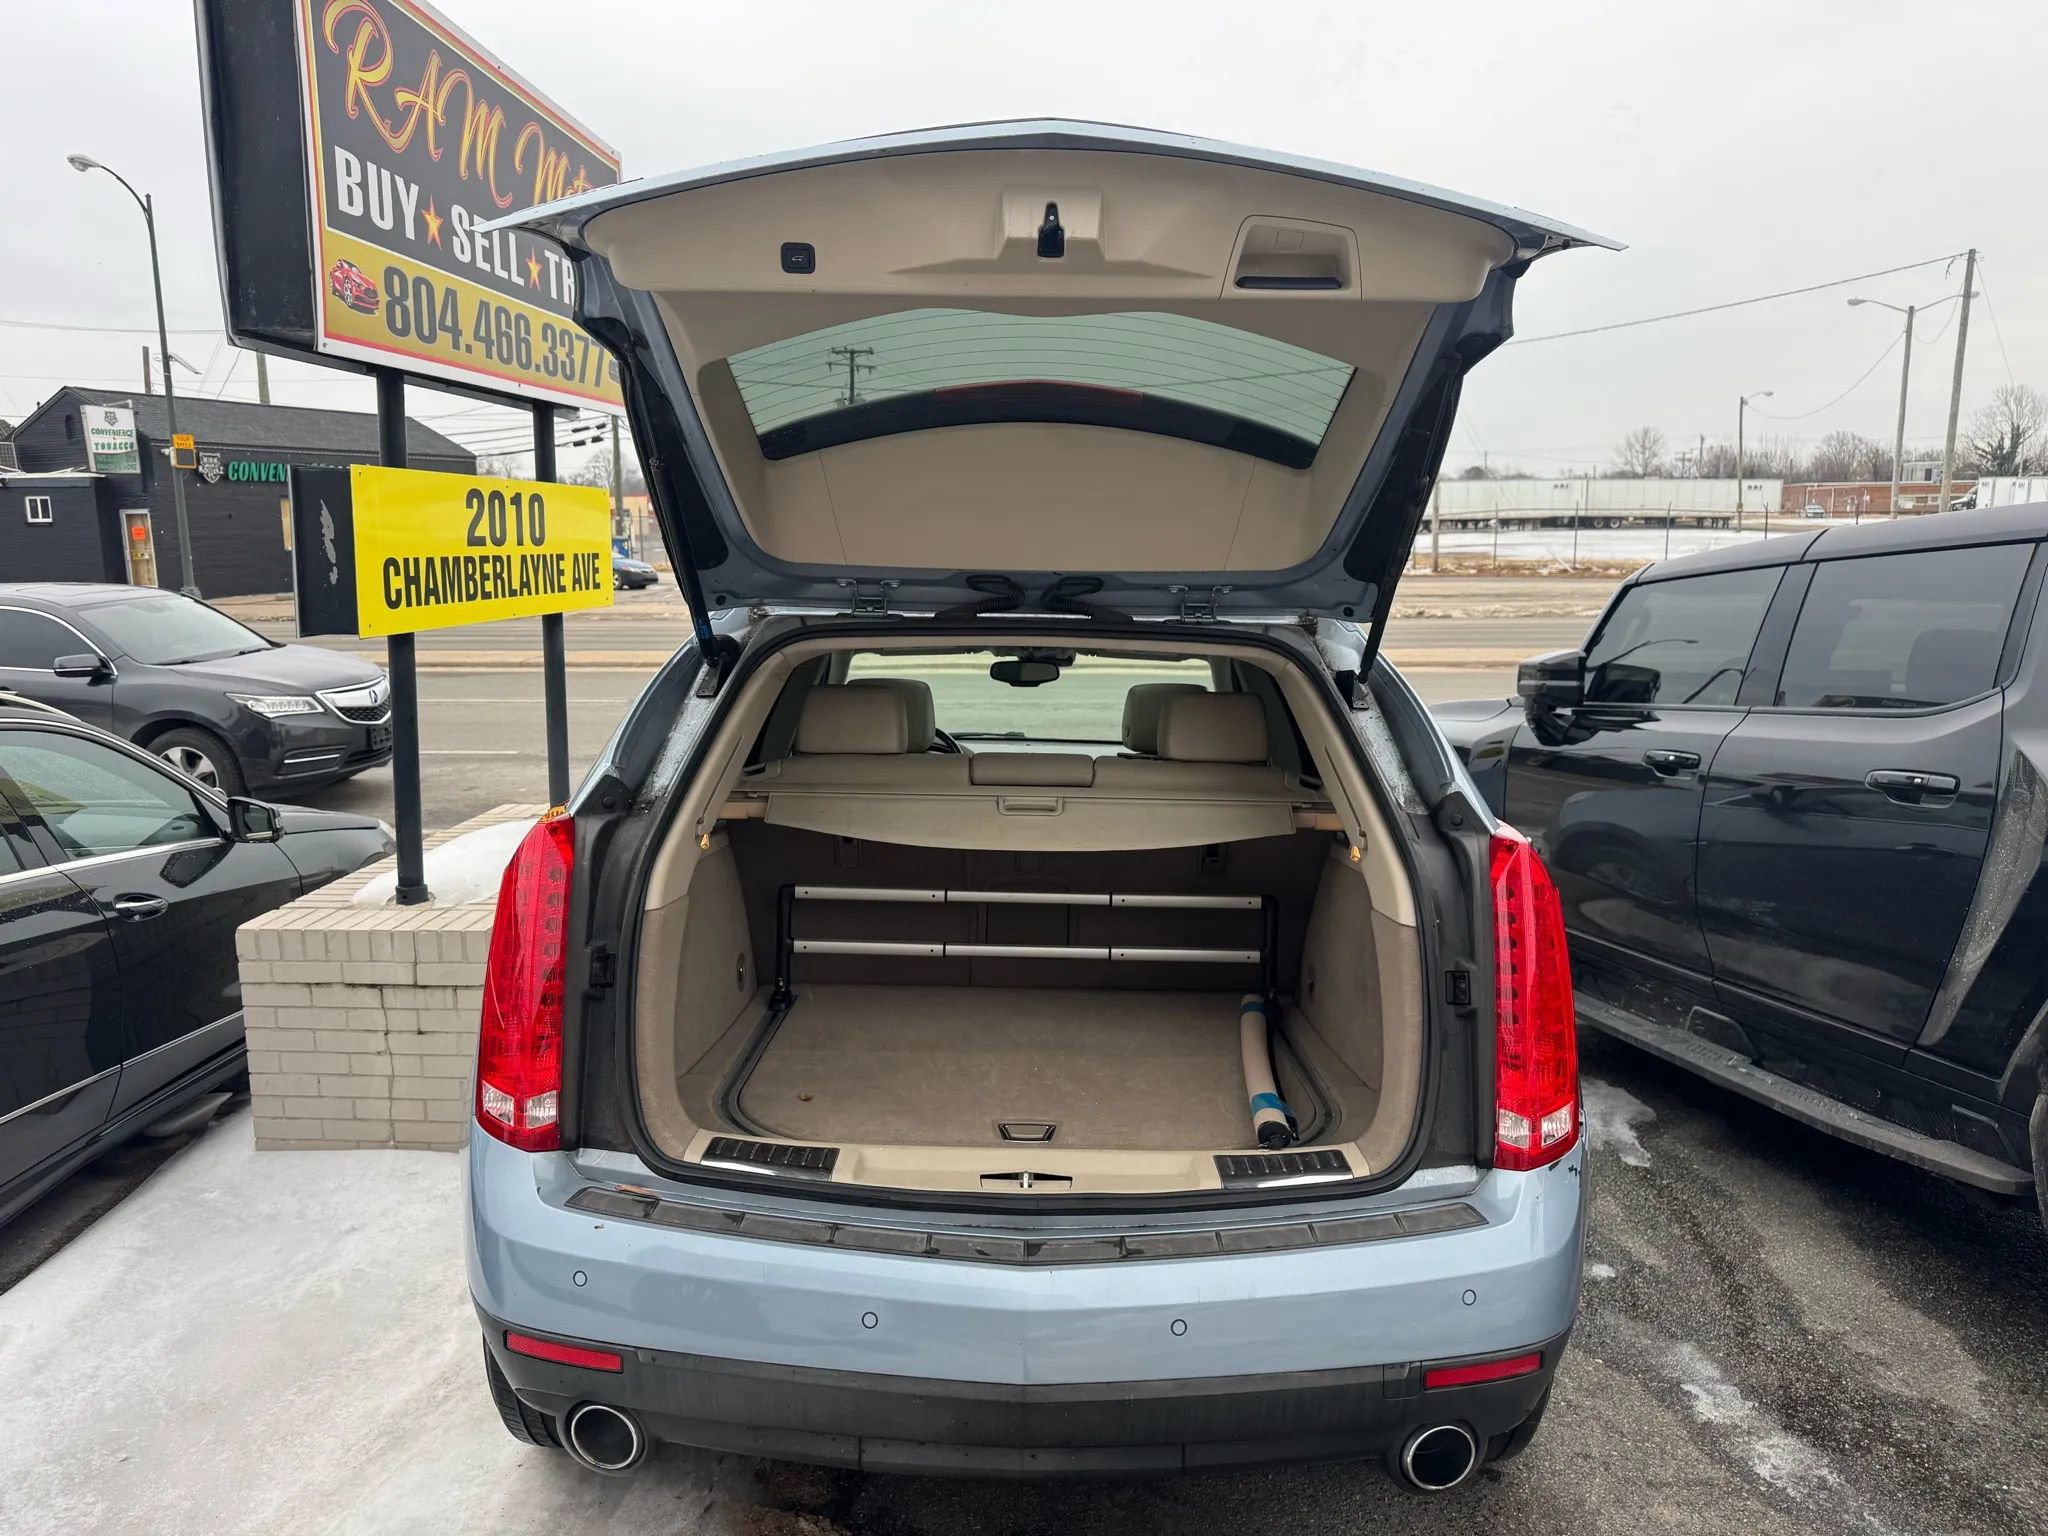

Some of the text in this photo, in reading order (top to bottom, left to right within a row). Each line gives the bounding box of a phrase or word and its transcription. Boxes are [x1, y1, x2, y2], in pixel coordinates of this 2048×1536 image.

[322, 0, 513, 208] RAM
[334, 145, 419, 240] BUY
[451, 204, 525, 288] SELL
[383, 265, 605, 388] 804.466.3377
[90, 427, 134, 438] CONVENIENCE
[94, 442, 134, 451] TOBACCO
[465, 488, 545, 547] 2010
[383, 552, 601, 610] CHAMBERLAYNE AVE
